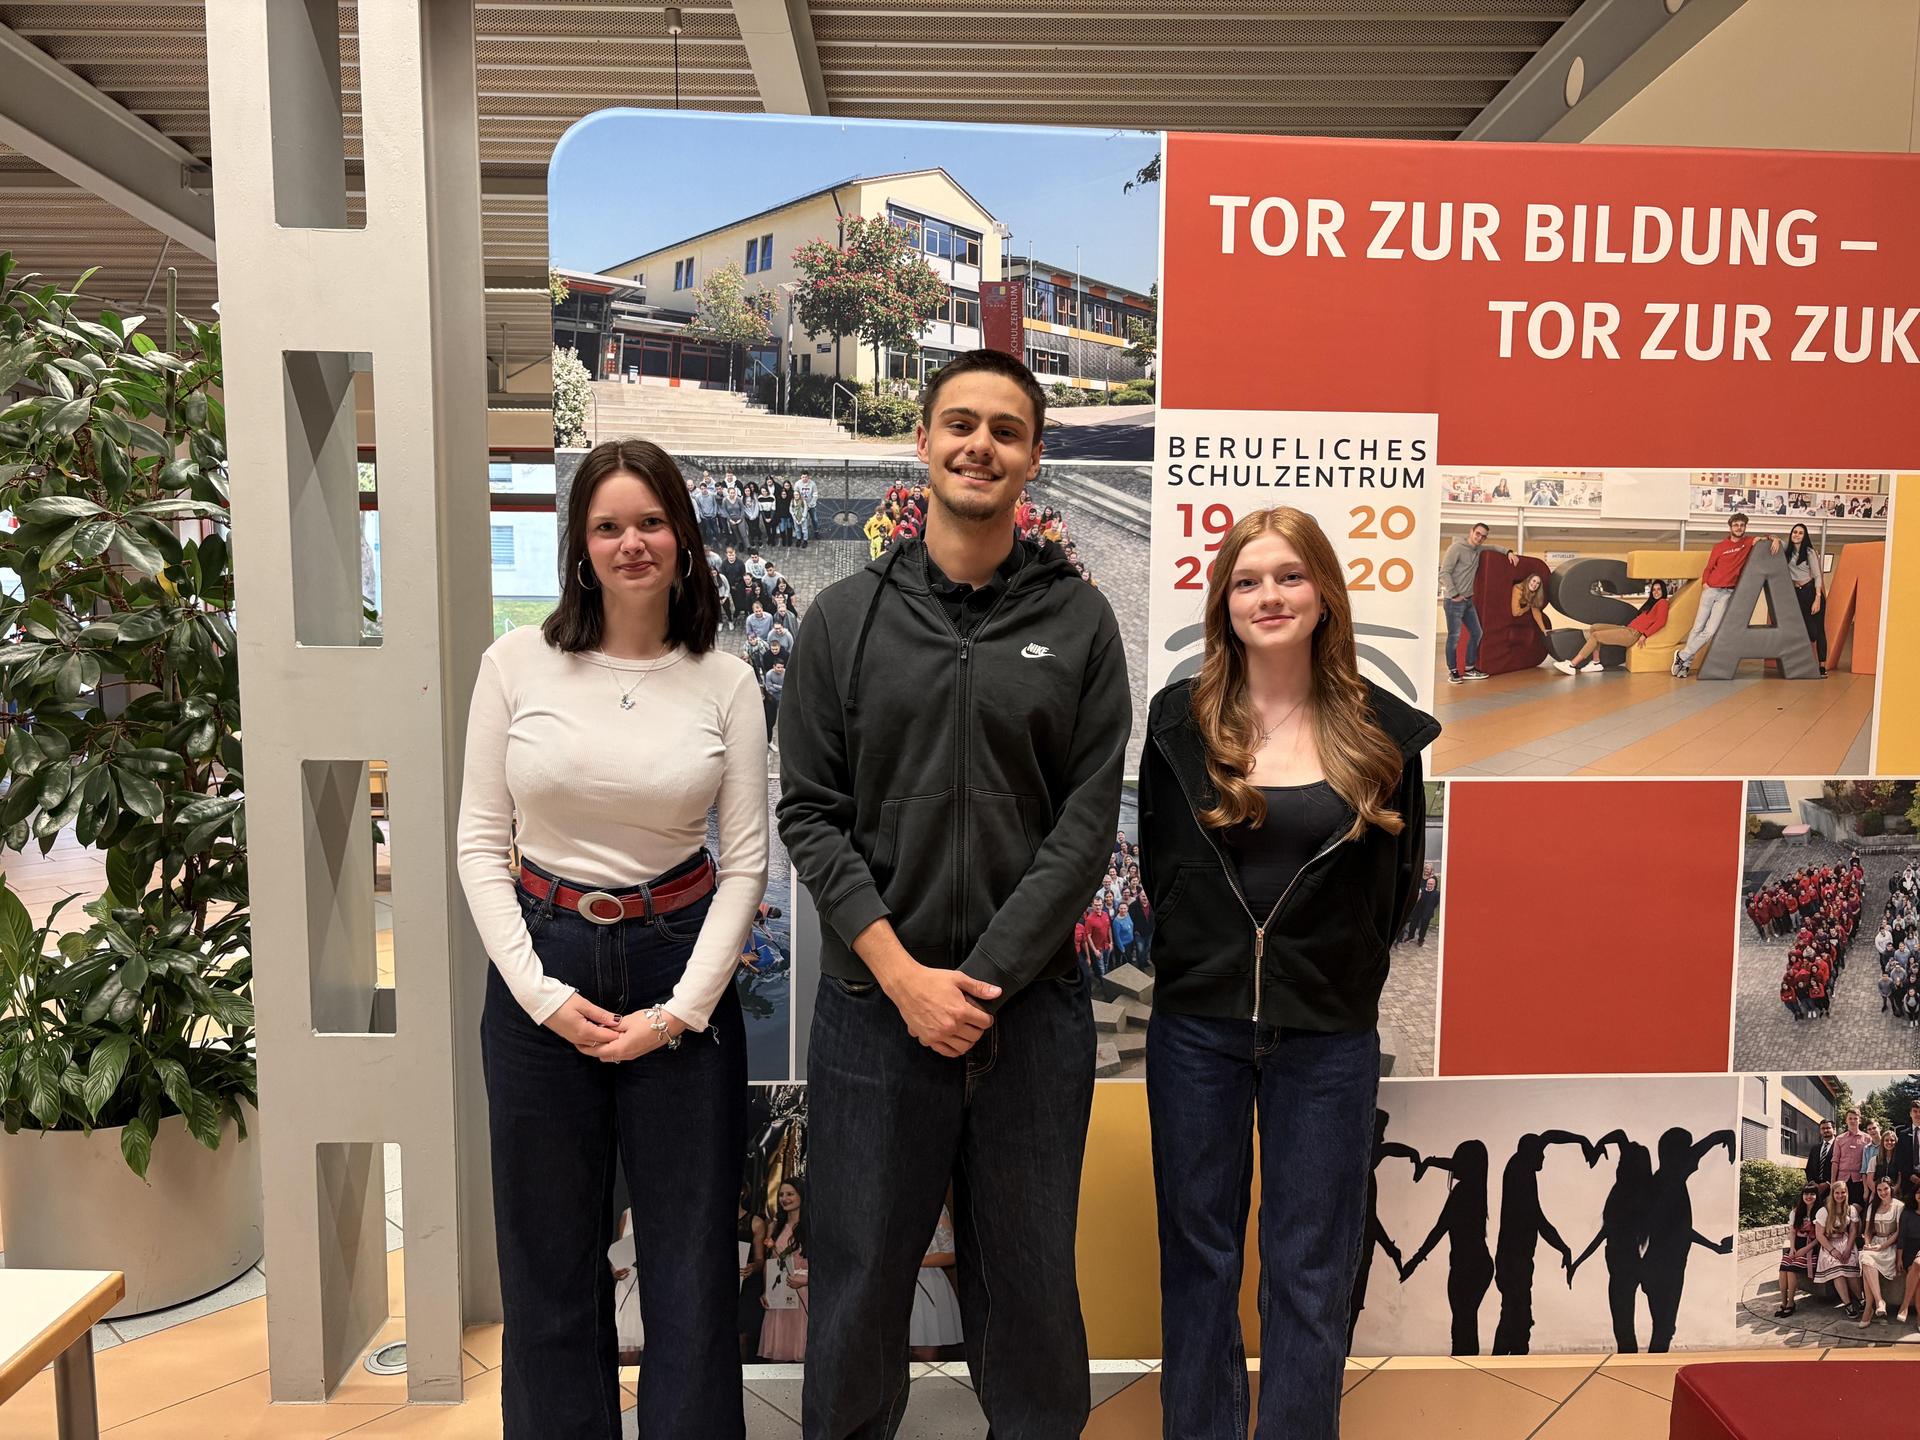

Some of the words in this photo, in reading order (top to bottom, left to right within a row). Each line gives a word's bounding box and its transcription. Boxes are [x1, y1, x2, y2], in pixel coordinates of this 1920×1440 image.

[1209, 194, 1347, 258] TOR
[1366, 200, 1501, 262] ZUR
[1524, 203, 1818, 267] BILDUNG
[1010, 285, 1018, 353] SCHULZENTRUM
[1488, 300, 1621, 360] TOR
[1640, 302, 1772, 361] ZUR
[1790, 305, 1920, 364] ZUK
[1169, 436, 1426, 462] BERUFLICHES
[1167, 464, 1425, 489] SCHULZENTRUM
[1177, 503, 1234, 552] 19
[1348, 505, 1416, 540] 20
[1347, 557, 1414, 592] 20
[1027, 642, 1049, 656] NIKE
